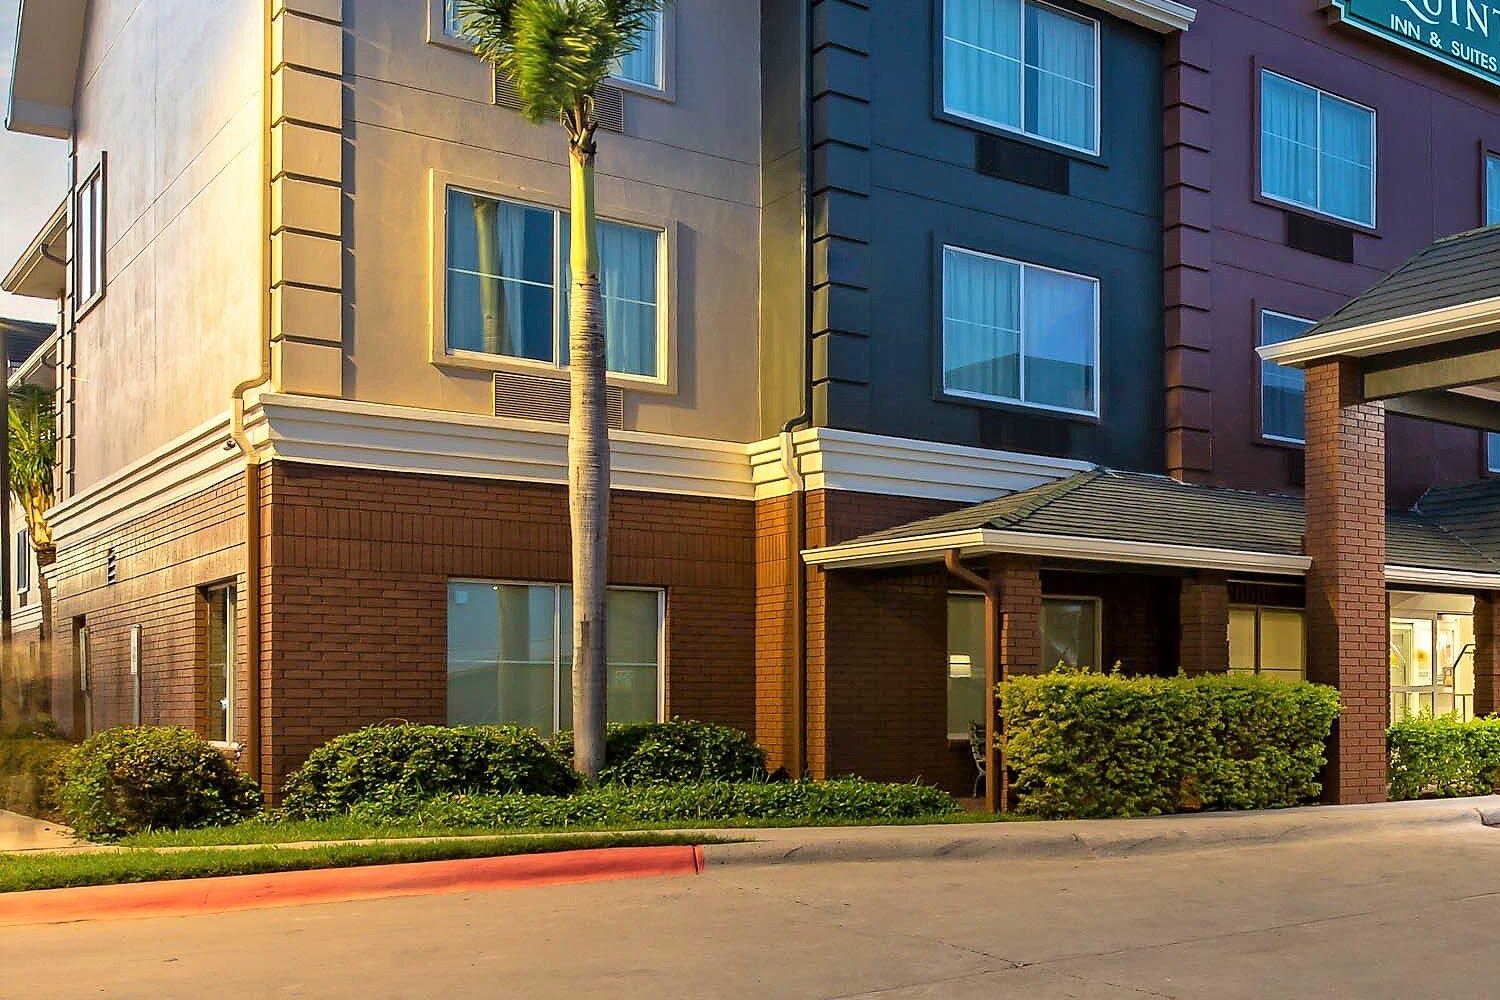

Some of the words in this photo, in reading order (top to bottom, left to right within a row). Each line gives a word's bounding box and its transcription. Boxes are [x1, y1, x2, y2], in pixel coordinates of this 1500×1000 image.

[1391, 13, 1420, 40] INN
[1429, 31, 1442, 49] &
[1451, 40, 1498, 72] SUITES
